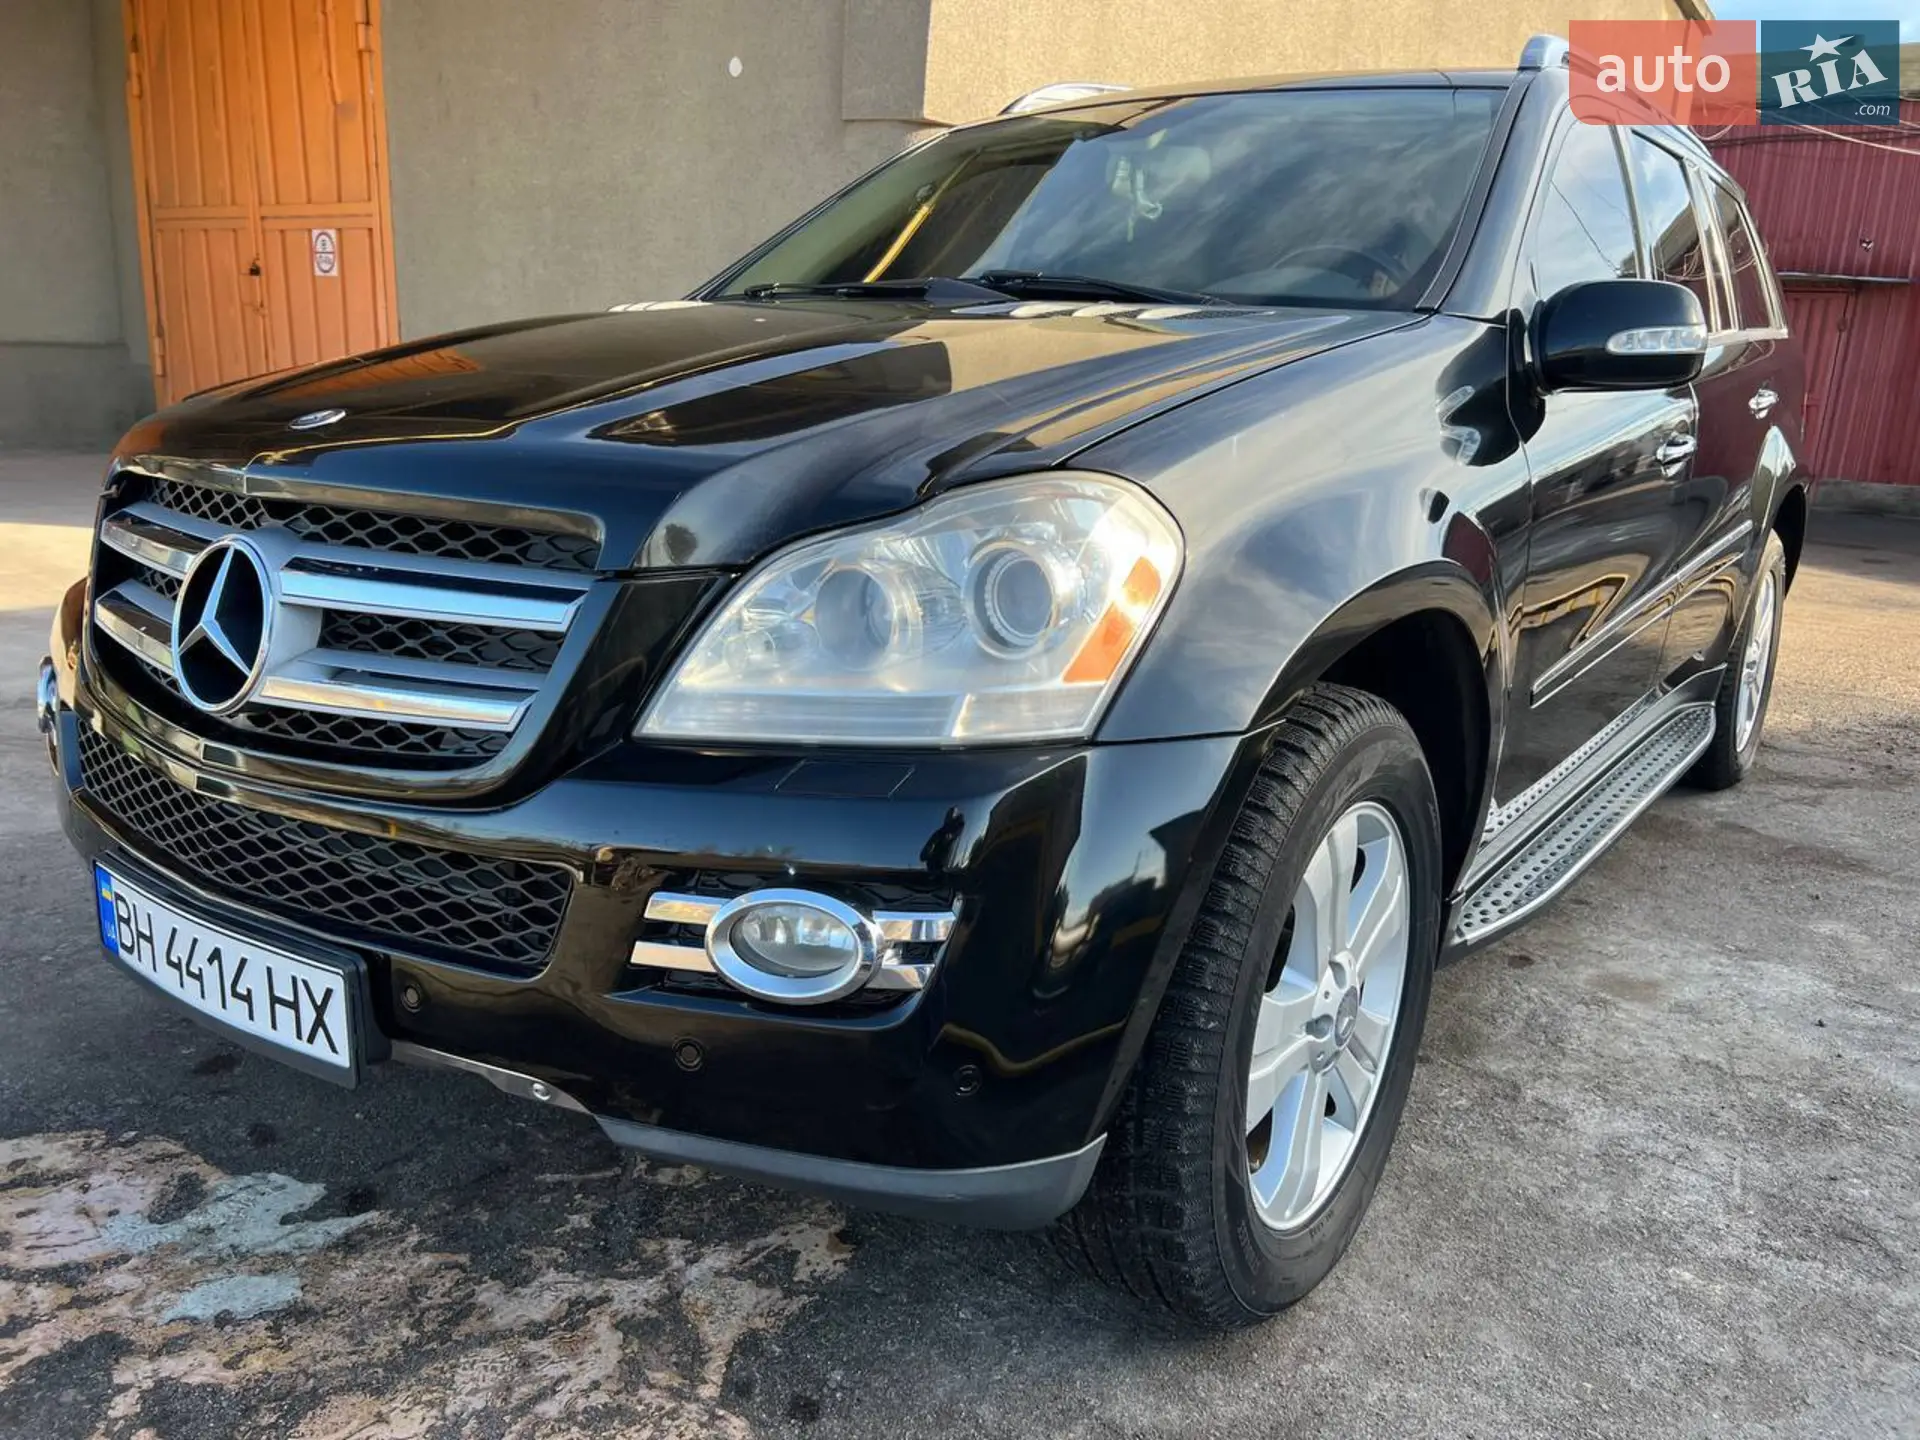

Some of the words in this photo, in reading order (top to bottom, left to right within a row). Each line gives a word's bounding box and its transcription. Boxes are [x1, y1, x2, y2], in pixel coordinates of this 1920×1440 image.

[114, 892, 157, 972] BH
[165, 927, 254, 1021] 4414
[266, 966, 338, 1055] HX
